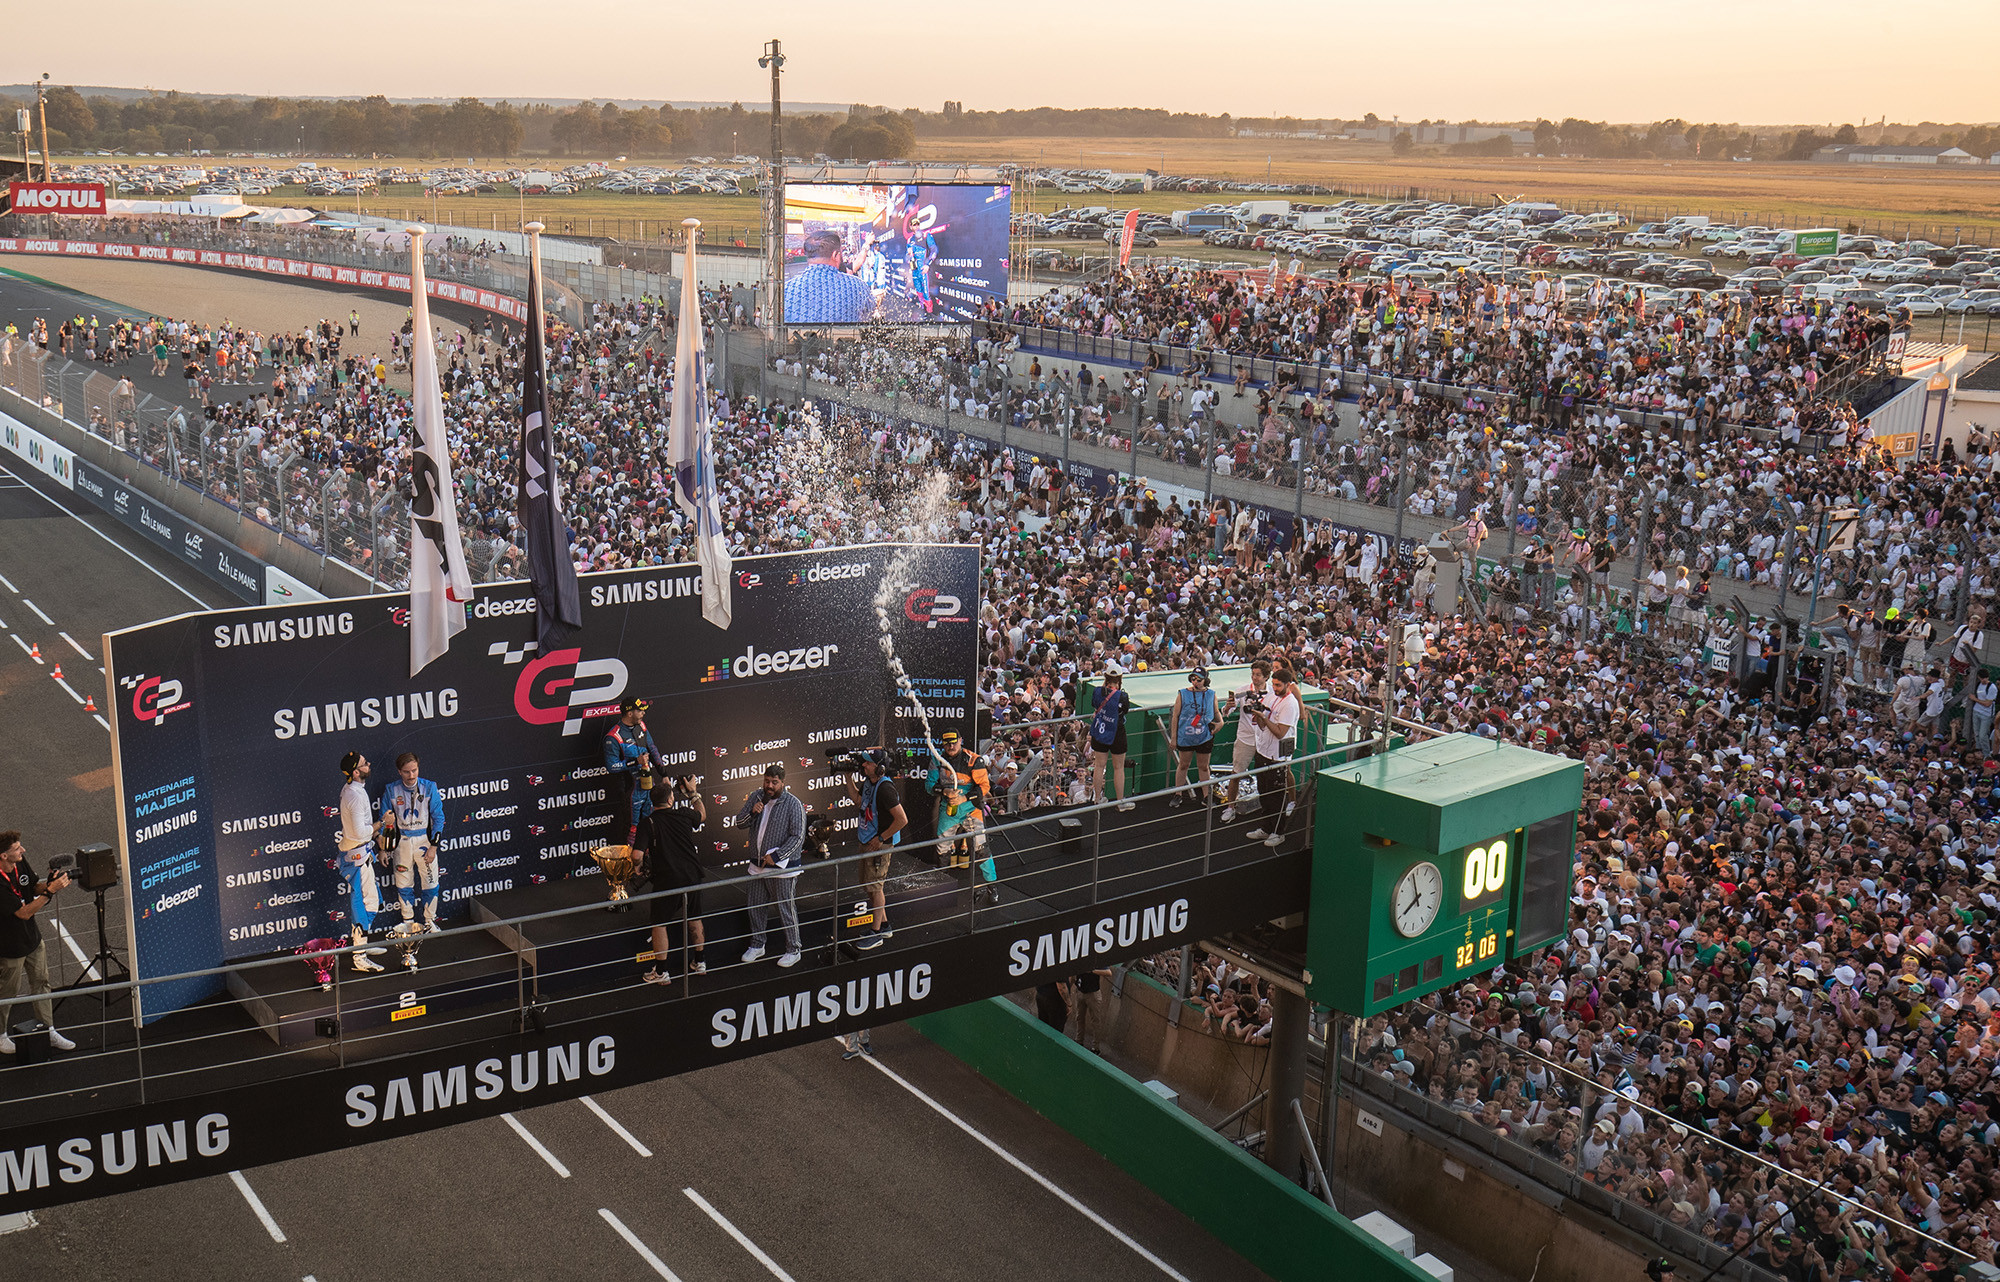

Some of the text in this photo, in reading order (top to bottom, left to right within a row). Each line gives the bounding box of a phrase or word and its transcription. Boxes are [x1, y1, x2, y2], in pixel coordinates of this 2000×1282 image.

[16, 188, 101, 209] MOTUL
[25, 241, 59, 252] MOTUL
[66, 242, 98, 254] MOTUL
[1801, 236, 1834, 245] Europcar
[104, 244, 134, 256] MOTUL
[139, 247, 168, 259] MOTUL
[172, 250, 196, 261] MOTUL
[200, 252, 222, 264] MOTUL
[225, 254, 244, 266] MOTUL
[245, 256, 264, 270] MOTUL
[267, 259, 285, 272] MOTUL
[939, 258, 982, 268] SAMSUNG
[288, 262, 308, 276] MOTUL
[312, 266, 332, 280] MOTUL
[336, 269, 358, 282] MOTUL
[360, 272, 383, 286] MOTUL
[388, 276, 411, 290] MOTUL
[958, 275, 990, 287] deezer
[438, 282, 456, 298] MOTUL
[940, 286, 982, 305] SAMSUNG
[1888, 338, 1903, 355] 22
[1896, 442, 1905, 450] 22
[1070, 464, 1093, 478] RÉGION
[91, 482, 104, 498] MANS
[150, 518, 156, 530] LE
[156, 521, 172, 540] MANS
[230, 566, 238, 580] LE
[238, 571, 258, 592] MANS
[807, 562, 871, 583] deezer
[591, 576, 702, 607] SAMSUNG
[474, 596, 536, 618] deeze
[214, 612, 354, 648] SAMSUNG
[733, 644, 838, 678] deezer
[1713, 657, 1728, 668] Lc14
[514, 647, 629, 736] GP
[133, 676, 183, 726] GP
[163, 702, 191, 715] EXPLORER
[274, 688, 459, 739] SAMSUNG
[585, 705, 621, 718] EXPLO
[894, 706, 965, 719] SAMSUNG
[808, 725, 868, 744] SAMSUNG
[754, 738, 790, 752] deezer
[661, 750, 697, 766] SUNG
[572, 766, 609, 780] deeze
[134, 776, 195, 803] PARTENAIRE
[438, 778, 510, 800] SAMSUNG
[136, 788, 196, 818] MAJEUR
[538, 789, 606, 810] SAMSUNG
[476, 804, 518, 820] deezer
[136, 810, 198, 844] SAMSUNG
[222, 810, 302, 834] SAMSUNG
[574, 814, 614, 829] deezer
[265, 838, 312, 854] deezer
[440, 829, 512, 852] SAMSUNG
[140, 847, 200, 876] PARTENAIRE
[477, 854, 520, 870] deezer
[1464, 840, 1508, 899] 00
[141, 860, 202, 890] OFFICIEL
[226, 864, 305, 888] SAMSUNG
[575, 866, 602, 877] deez
[156, 884, 202, 912] deezer
[268, 890, 315, 907] deezer
[442, 879, 513, 902] SAMSUNG
[854, 902, 868, 916] 3
[229, 916, 308, 941] SAMSUNG
[850, 916, 872, 926] PIRELLI
[1008, 898, 1189, 976] SAMSUNG
[1479, 934, 1496, 959] 06
[640, 952, 656, 960] PIRE
[1456, 943, 1474, 968] 32
[400, 992, 416, 1008] 2
[711, 963, 932, 1048] SAMSUNG
[345, 1037, 616, 1128] SAMSUNG
[0, 1113, 230, 1194] MSUNG
